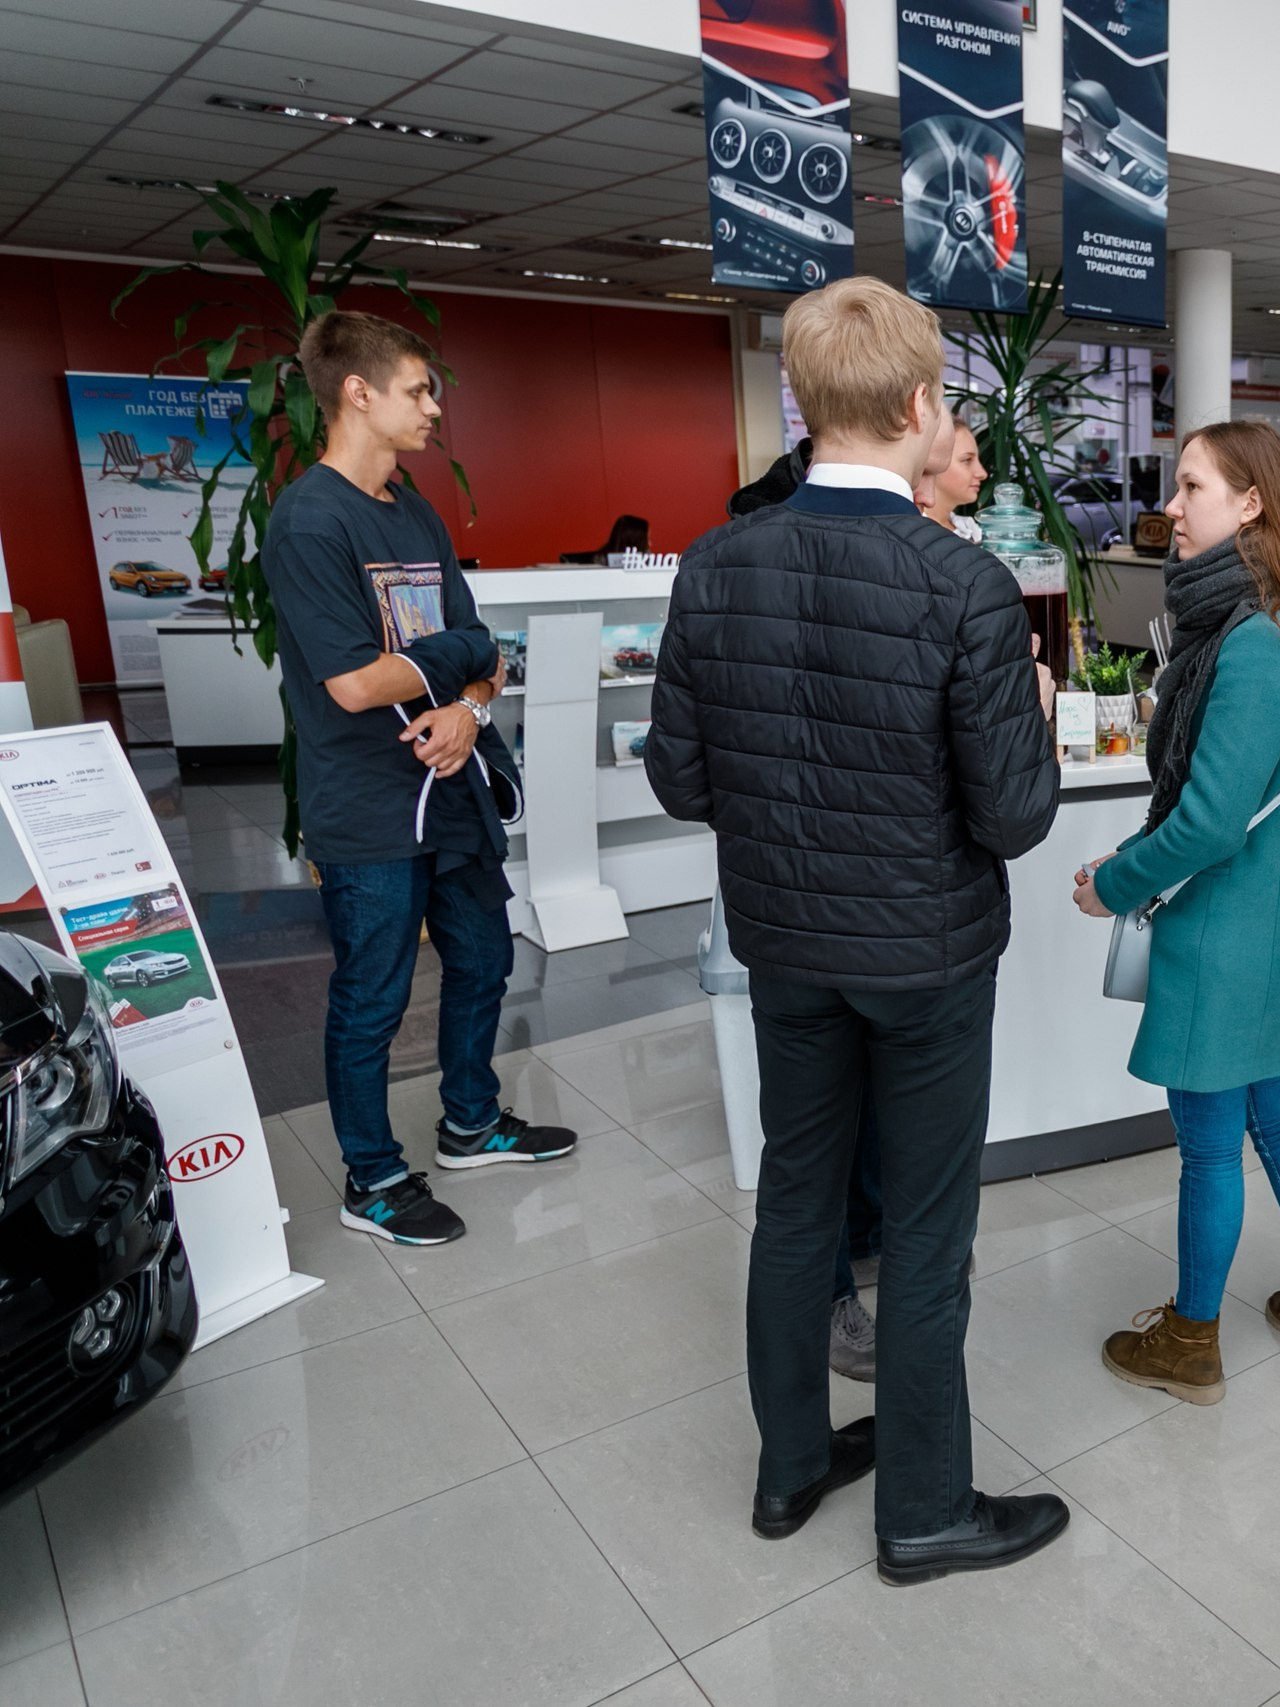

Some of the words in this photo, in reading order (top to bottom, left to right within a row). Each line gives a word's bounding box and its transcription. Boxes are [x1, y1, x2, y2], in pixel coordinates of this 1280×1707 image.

[902, 9, 953, 31] СИСТЕМА
[954, 21, 1021, 47] УПРАВЛЕНИЯ
[936, 33, 992, 56] РАЗГОНОМ
[1083, 231, 1152, 253] 8-СТУПЕНЧАТАЯ
[1077, 245, 1155, 267] АВТОМАТИЧЕСКАЯ
[1085, 260, 1147, 280] ТРАНСМИССИЯ
[149, 390, 178, 403] ГОД
[12, 779, 57, 790] OPTIMA
[177, 1141, 233, 1177] KIA
